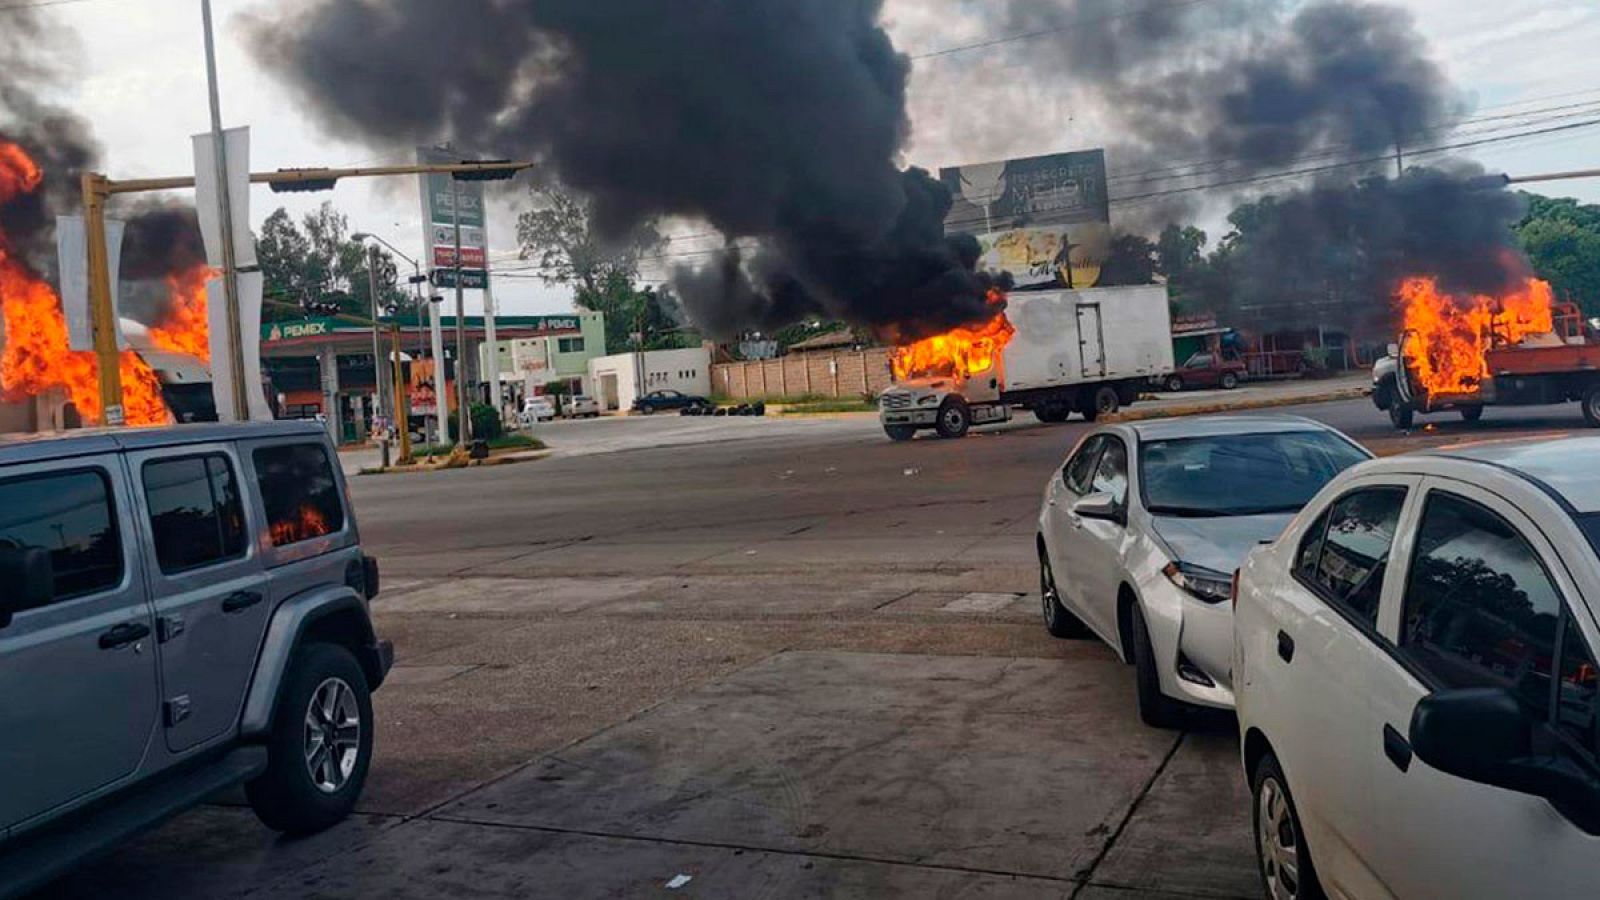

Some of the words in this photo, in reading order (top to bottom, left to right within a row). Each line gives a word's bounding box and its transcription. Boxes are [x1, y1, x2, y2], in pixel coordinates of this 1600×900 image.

[1012, 177, 1096, 204] MEJOR
[283, 321, 327, 338] PEMEX
[547, 319, 577, 329] PEMEX
